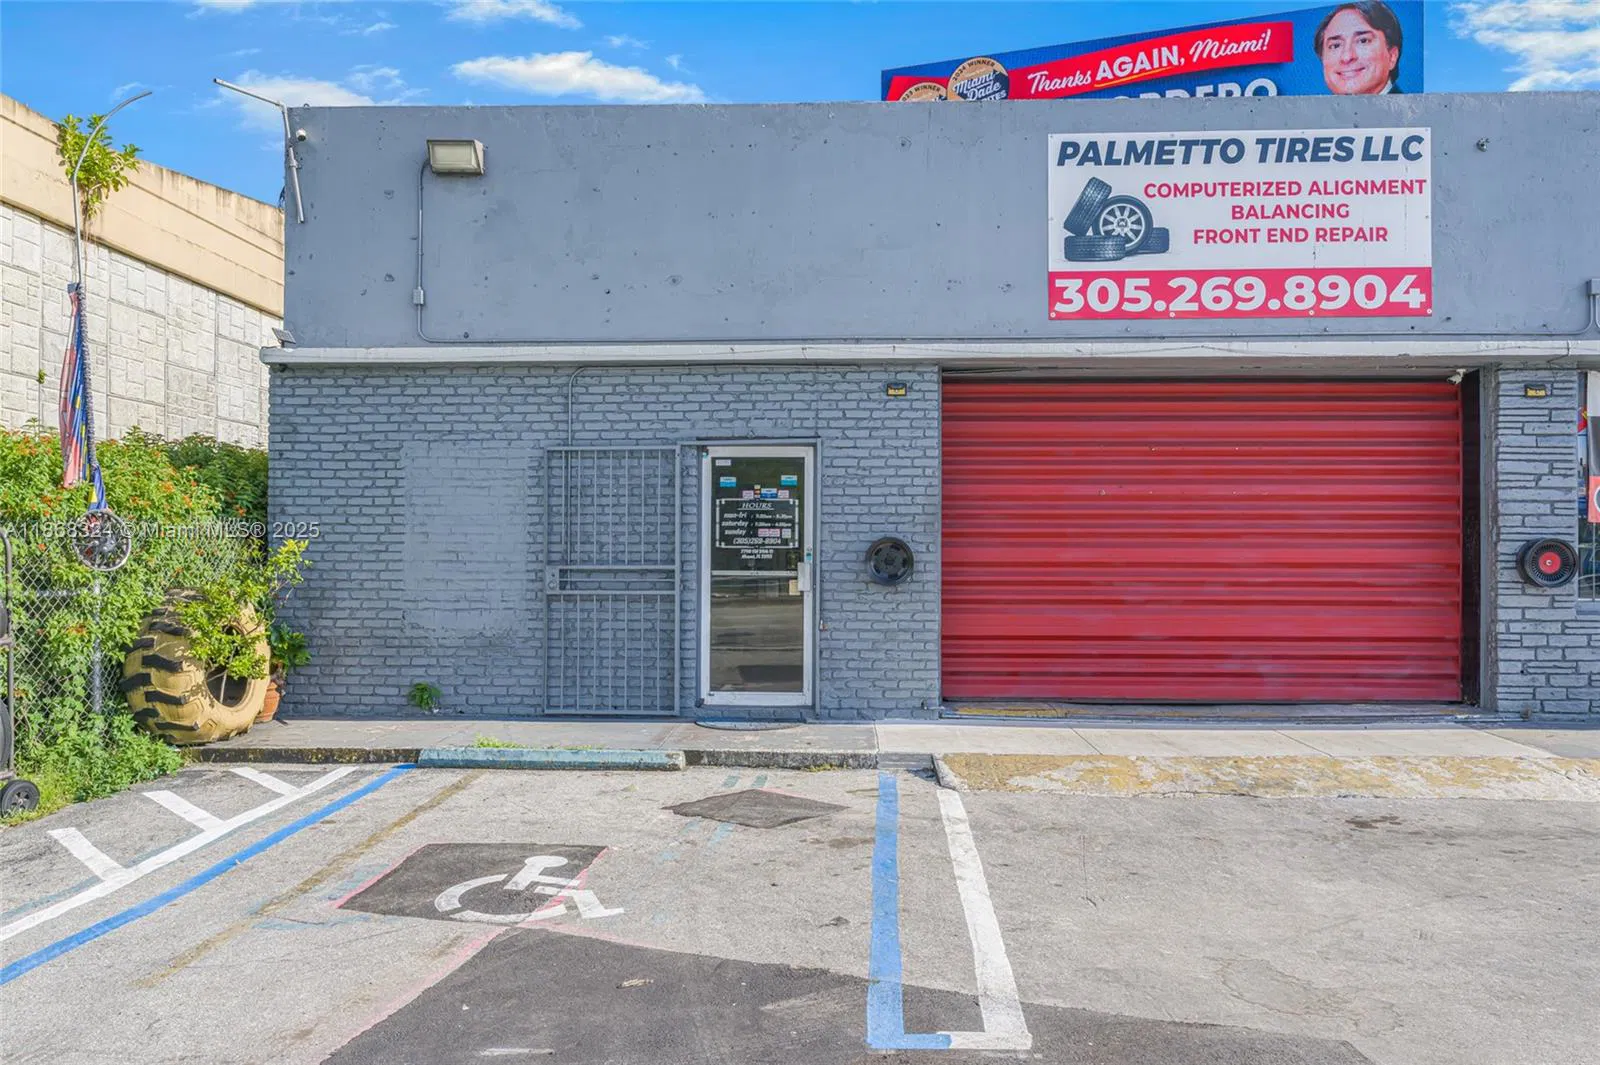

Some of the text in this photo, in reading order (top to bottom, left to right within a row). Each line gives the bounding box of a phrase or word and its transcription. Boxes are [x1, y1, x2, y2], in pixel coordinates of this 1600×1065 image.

[967, 59, 996, 67] WINNER
[1028, 70, 1092, 94] Thanks
[1095, 45, 1185, 81] AGAIN,
[1189, 28, 1272, 63] Miami!
[967, 81, 1002, 101] Dade
[1056, 135, 1425, 167] PALMETTO TIRES LLC
[1144, 179, 1427, 199] COMPUTERIZED ALIGNMENT
[1231, 203, 1350, 220] BALANCING
[1193, 226, 1388, 244] FRONT END REPAIR
[1054, 274, 1426, 313] 305.269.8904
